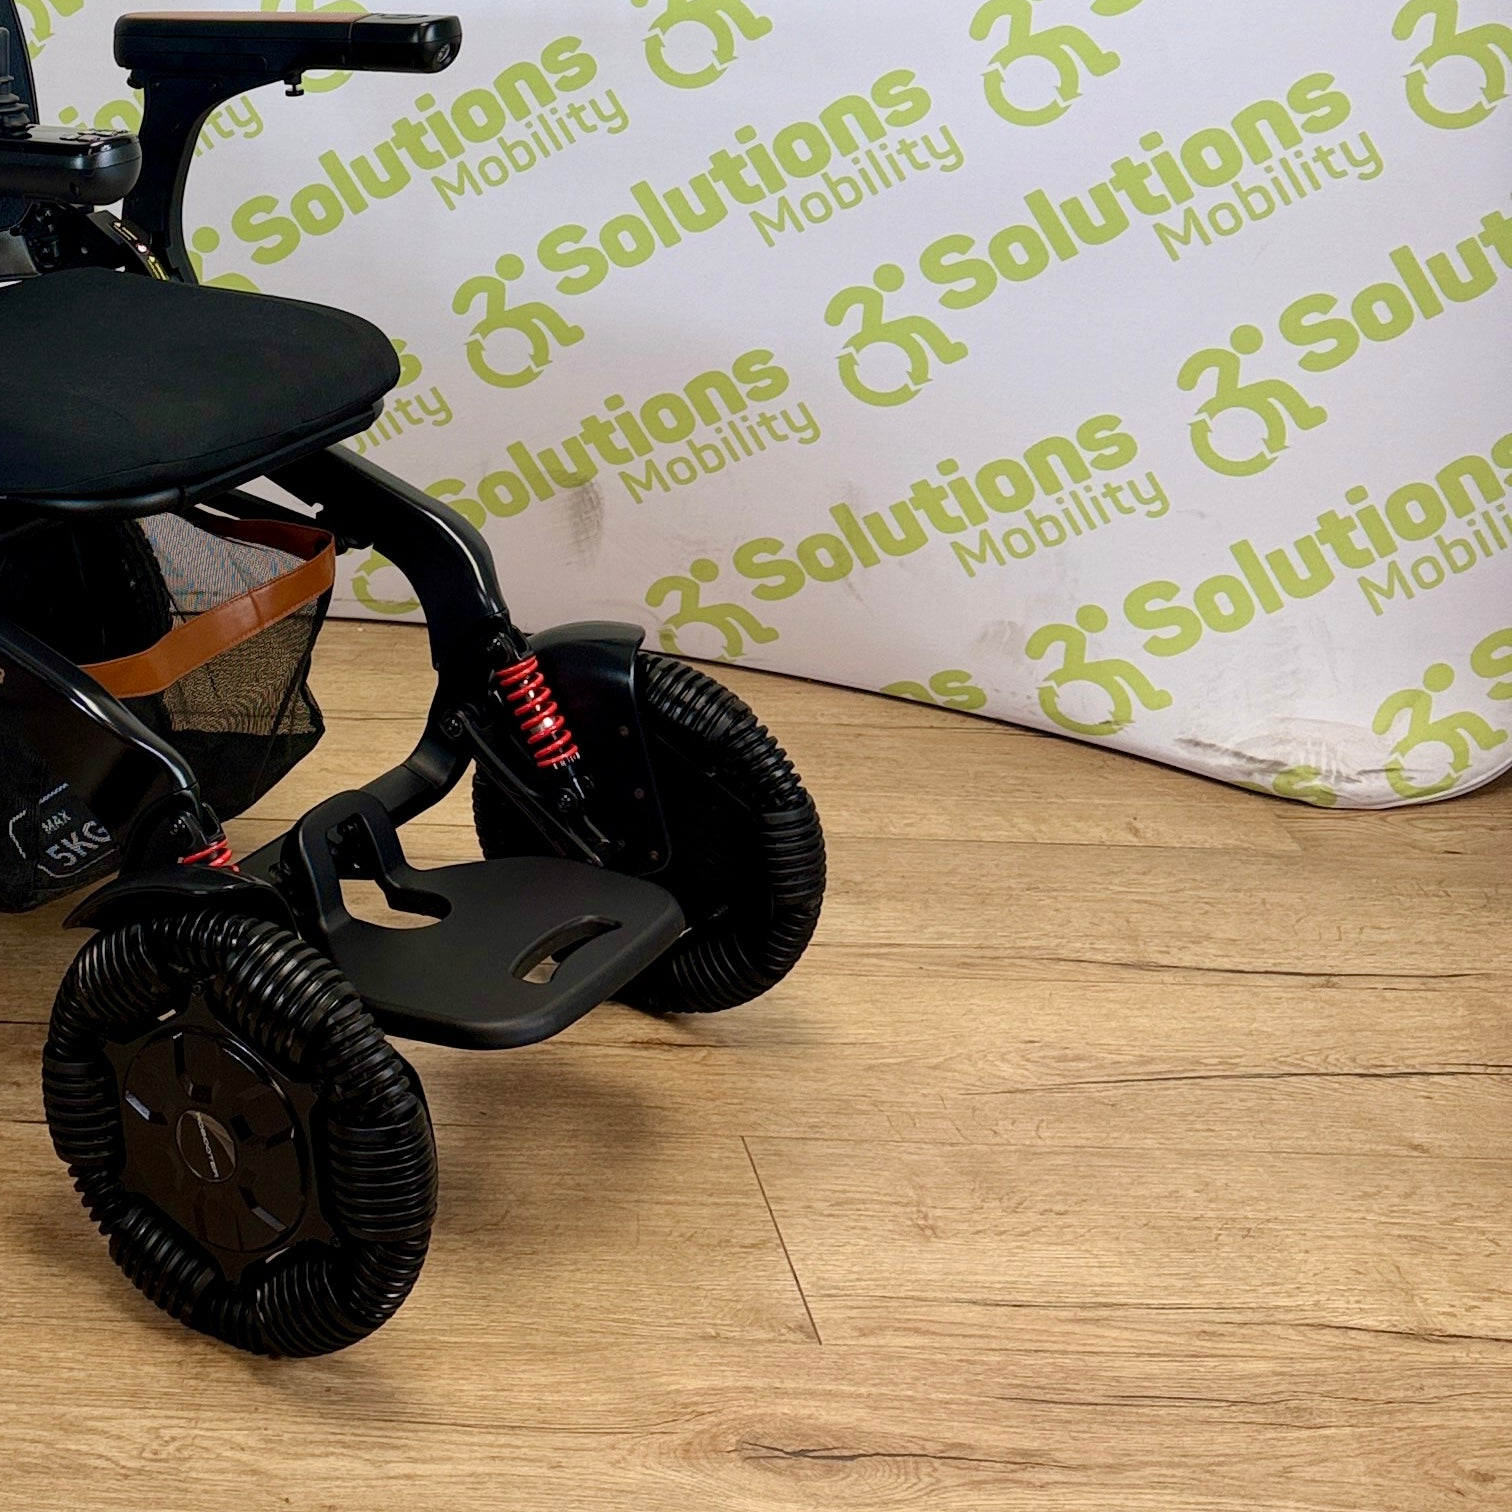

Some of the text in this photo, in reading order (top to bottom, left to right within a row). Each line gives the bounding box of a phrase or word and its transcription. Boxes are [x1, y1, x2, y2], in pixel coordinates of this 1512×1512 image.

[231, 35, 598, 266] Solutions
[430, 88, 630, 212] Mobility
[537, 68, 931, 296] Solutions
[748, 125, 965, 248] Mobility
[919, 72, 1352, 310] Solutions
[1152, 131, 1384, 262] Mobility
[619, 400, 822, 505] Mobility
[733, 414, 1138, 601] Solutions
[949, 471, 1171, 578] Mobility
[46, 820, 112, 867] 5KG
